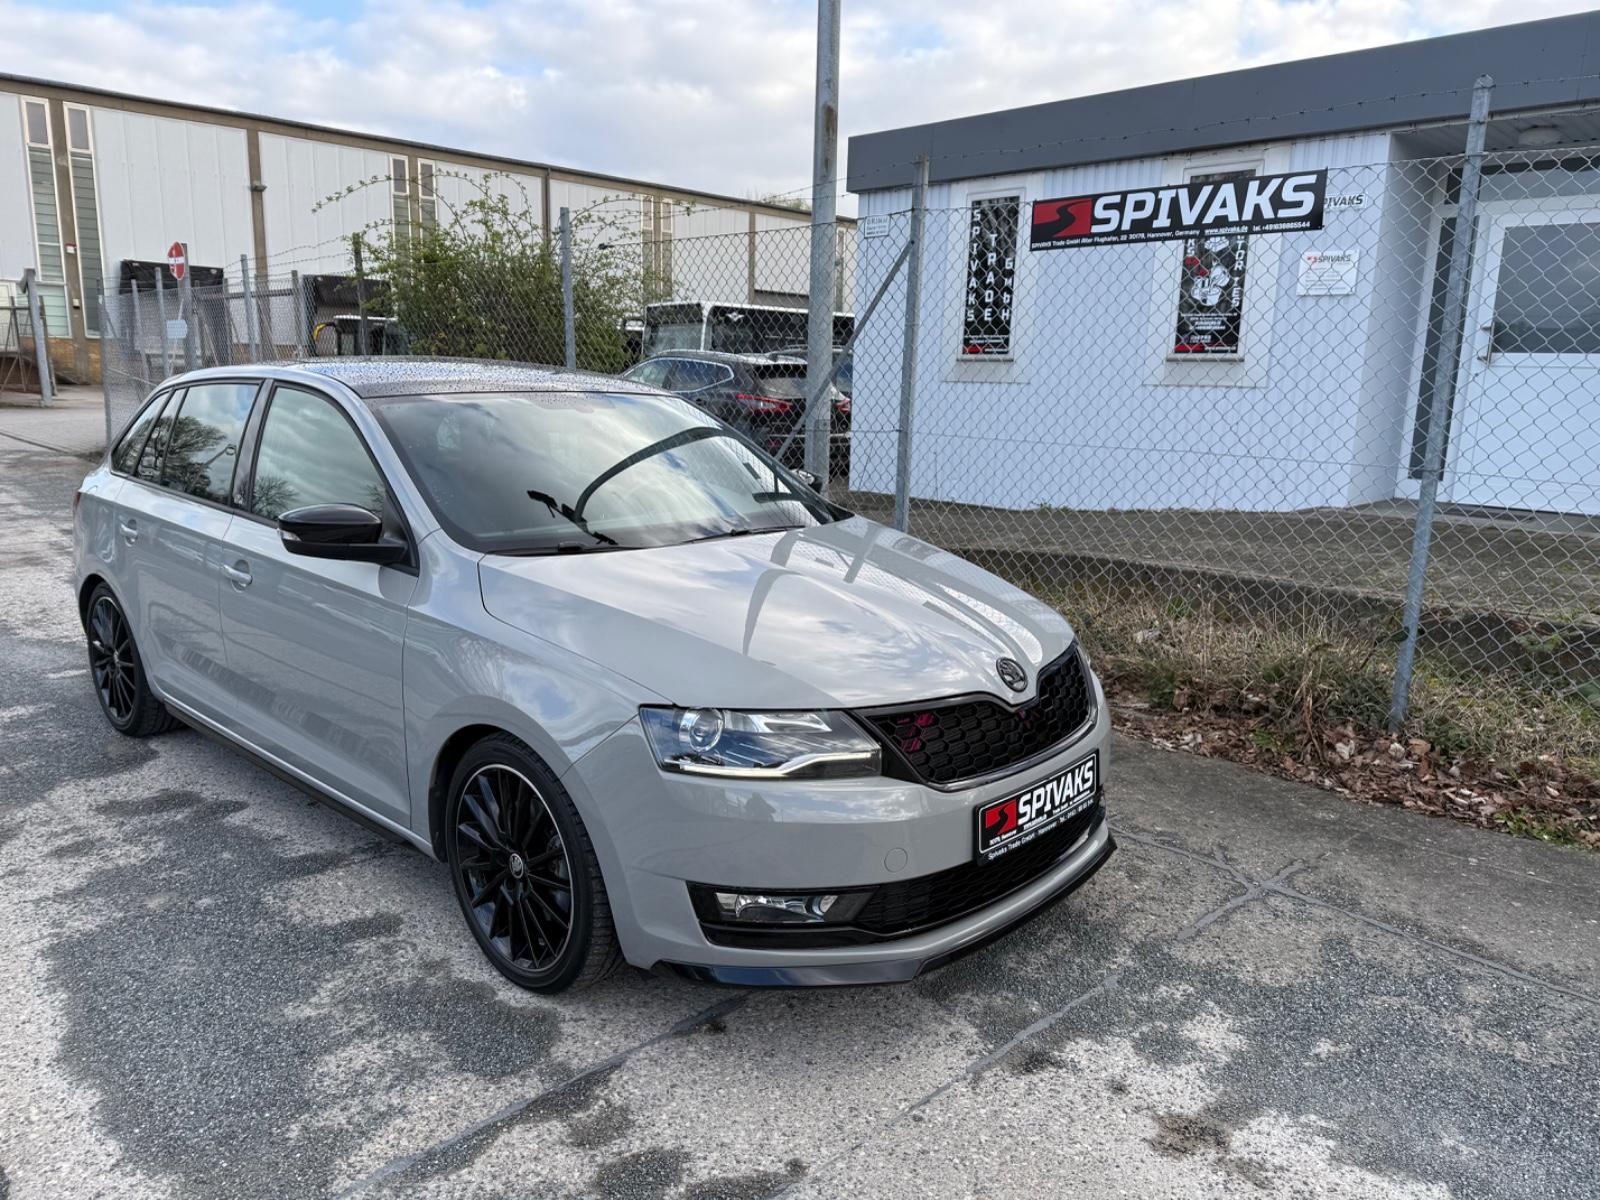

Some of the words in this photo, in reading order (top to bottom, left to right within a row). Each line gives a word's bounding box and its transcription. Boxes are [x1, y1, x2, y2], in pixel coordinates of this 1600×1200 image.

[1090, 173, 1318, 233] SPIVAKS
[1147, 231, 1174, 239] Hannover,
[1174, 229, 1200, 237] Germany
[966, 209, 981, 322] SPIVAKS
[984, 233, 998, 321] TRADE
[1318, 254, 1351, 263] SPIVAKS
[1018, 760, 1094, 826] SPIVAKS
